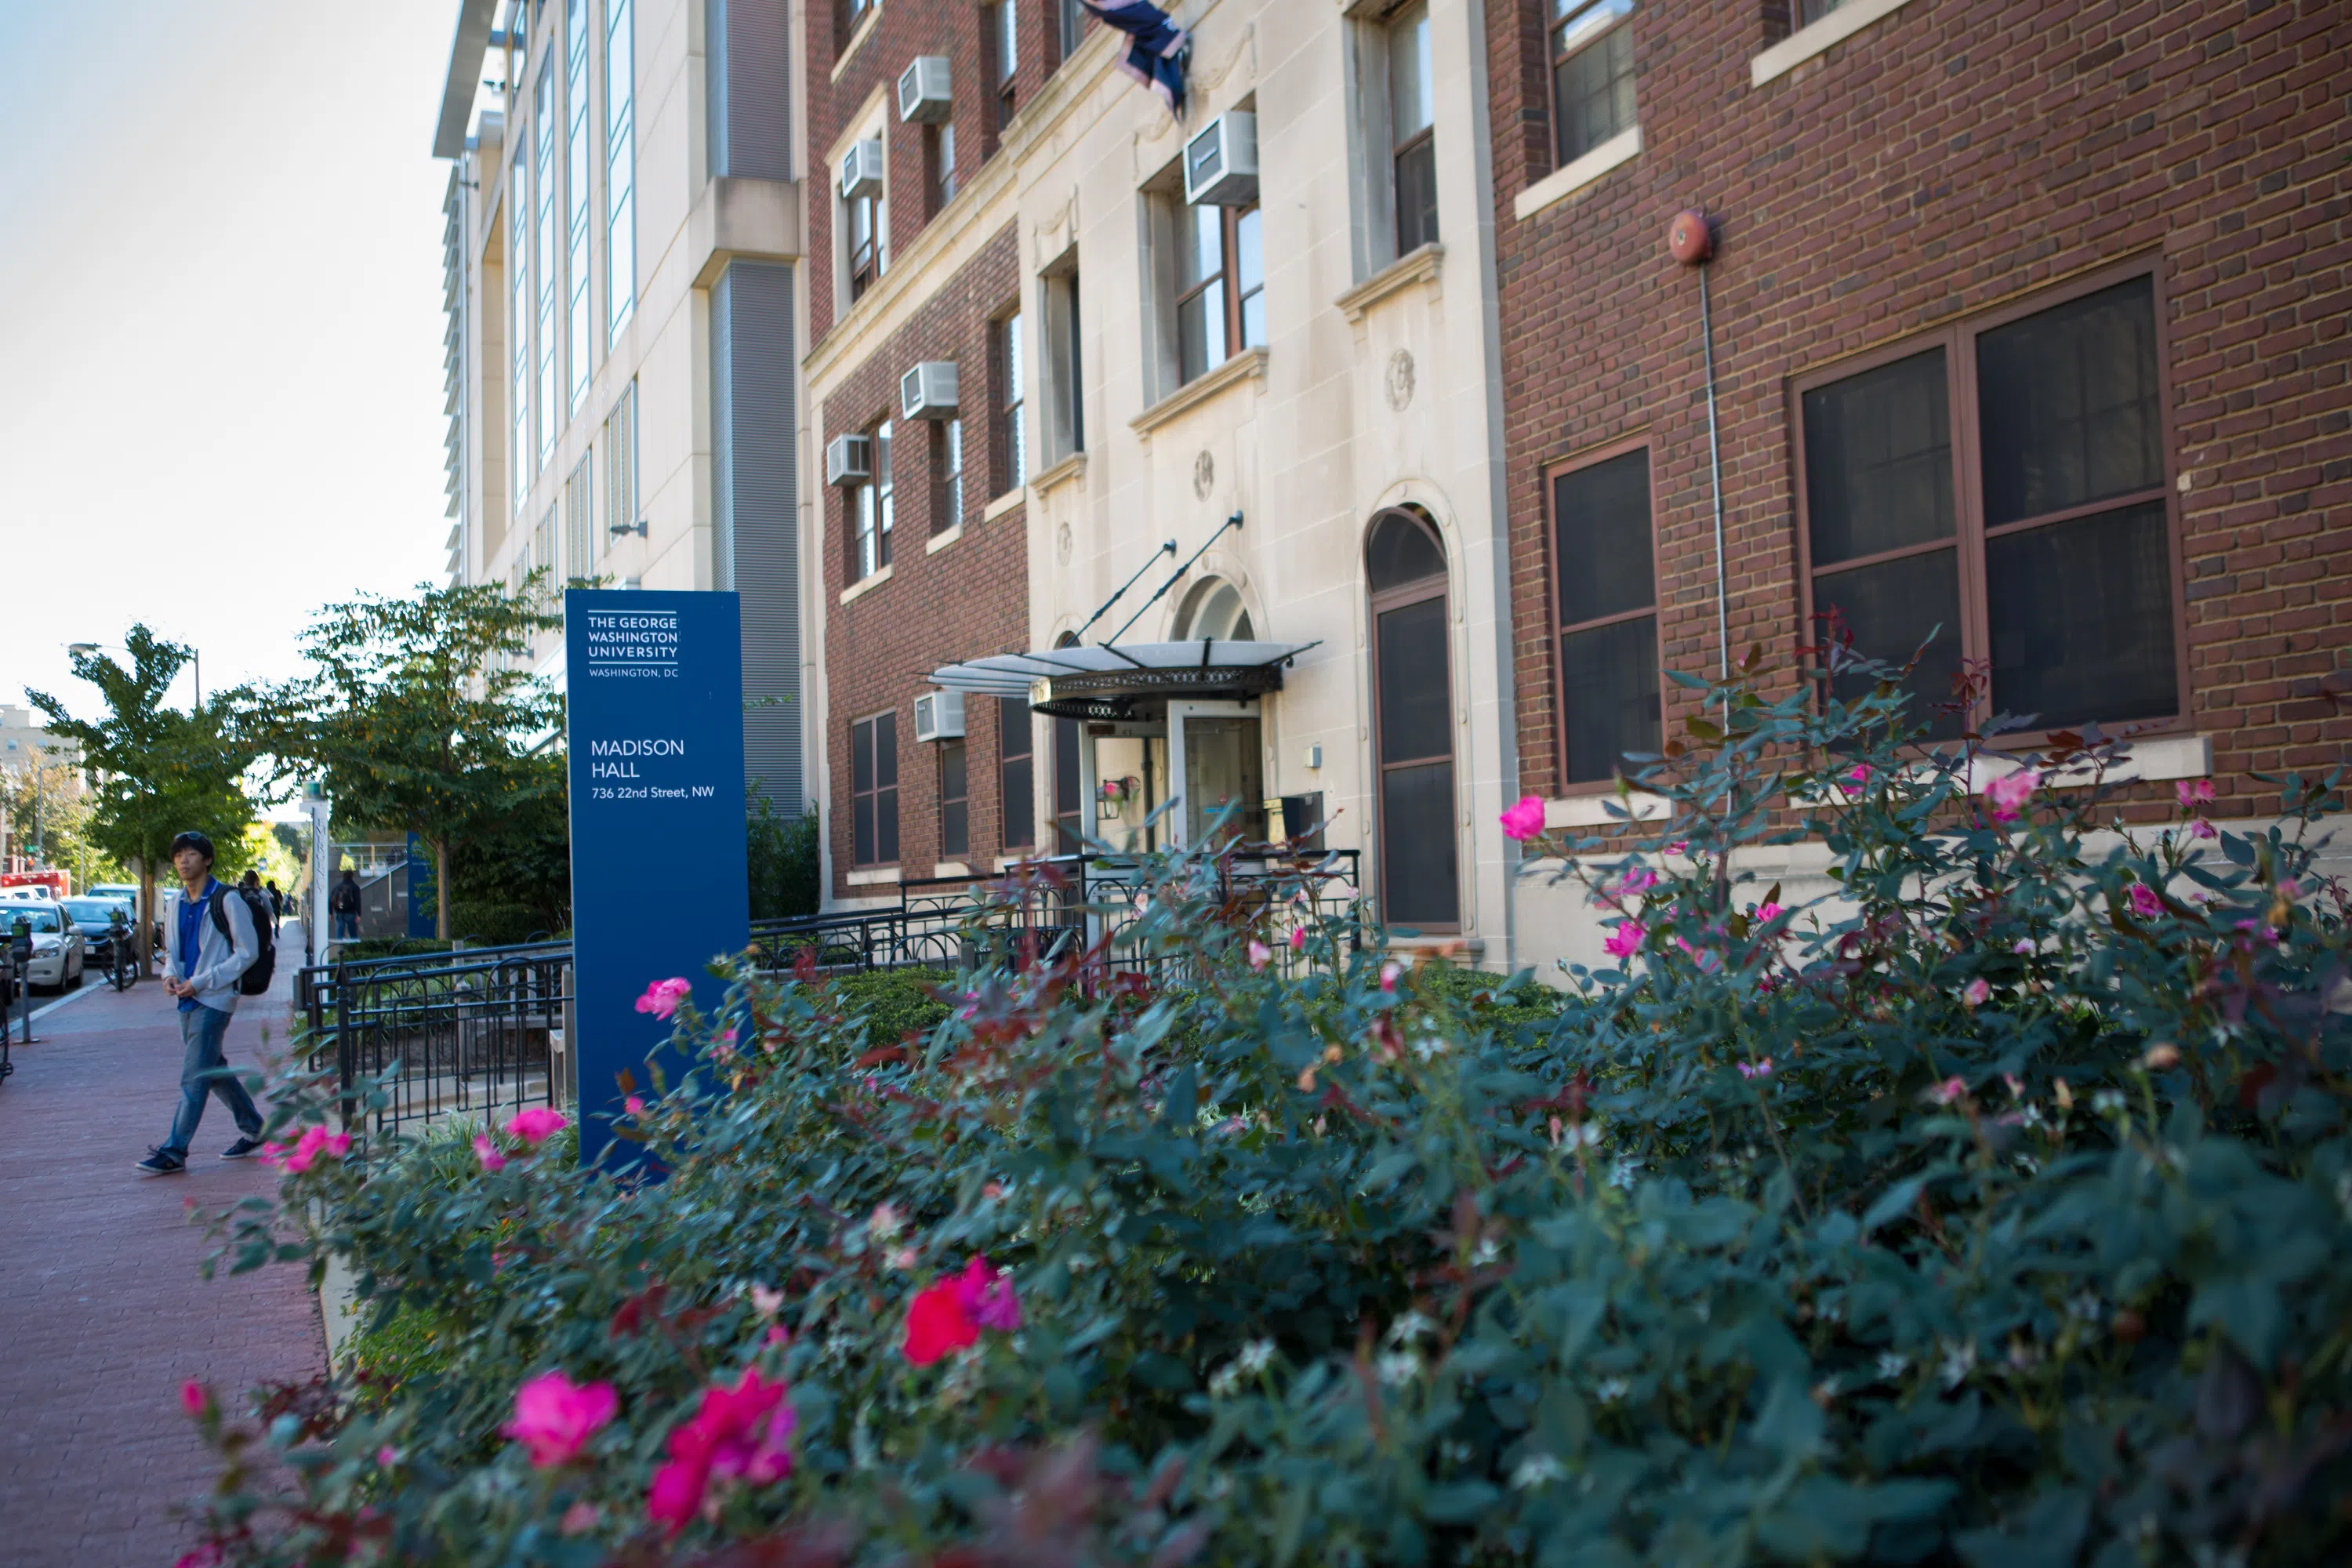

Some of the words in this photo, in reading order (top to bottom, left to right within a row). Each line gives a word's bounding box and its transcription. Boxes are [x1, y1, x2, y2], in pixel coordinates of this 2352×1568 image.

[588, 617, 616, 628] THE
[619, 617, 677, 629] GEORGE
[588, 631, 678, 643] WASHINGTON
[588, 646, 677, 658] UNIVERSITY
[589, 669, 661, 678] WASHINGTON,
[664, 669, 678, 677] DC
[591, 739, 684, 756] MADISON
[592, 762, 641, 778] HALL
[592, 787, 614, 799] 736
[617, 786, 648, 799] 22nd
[651, 786, 688, 799] Street,
[691, 786, 714, 797] NW
